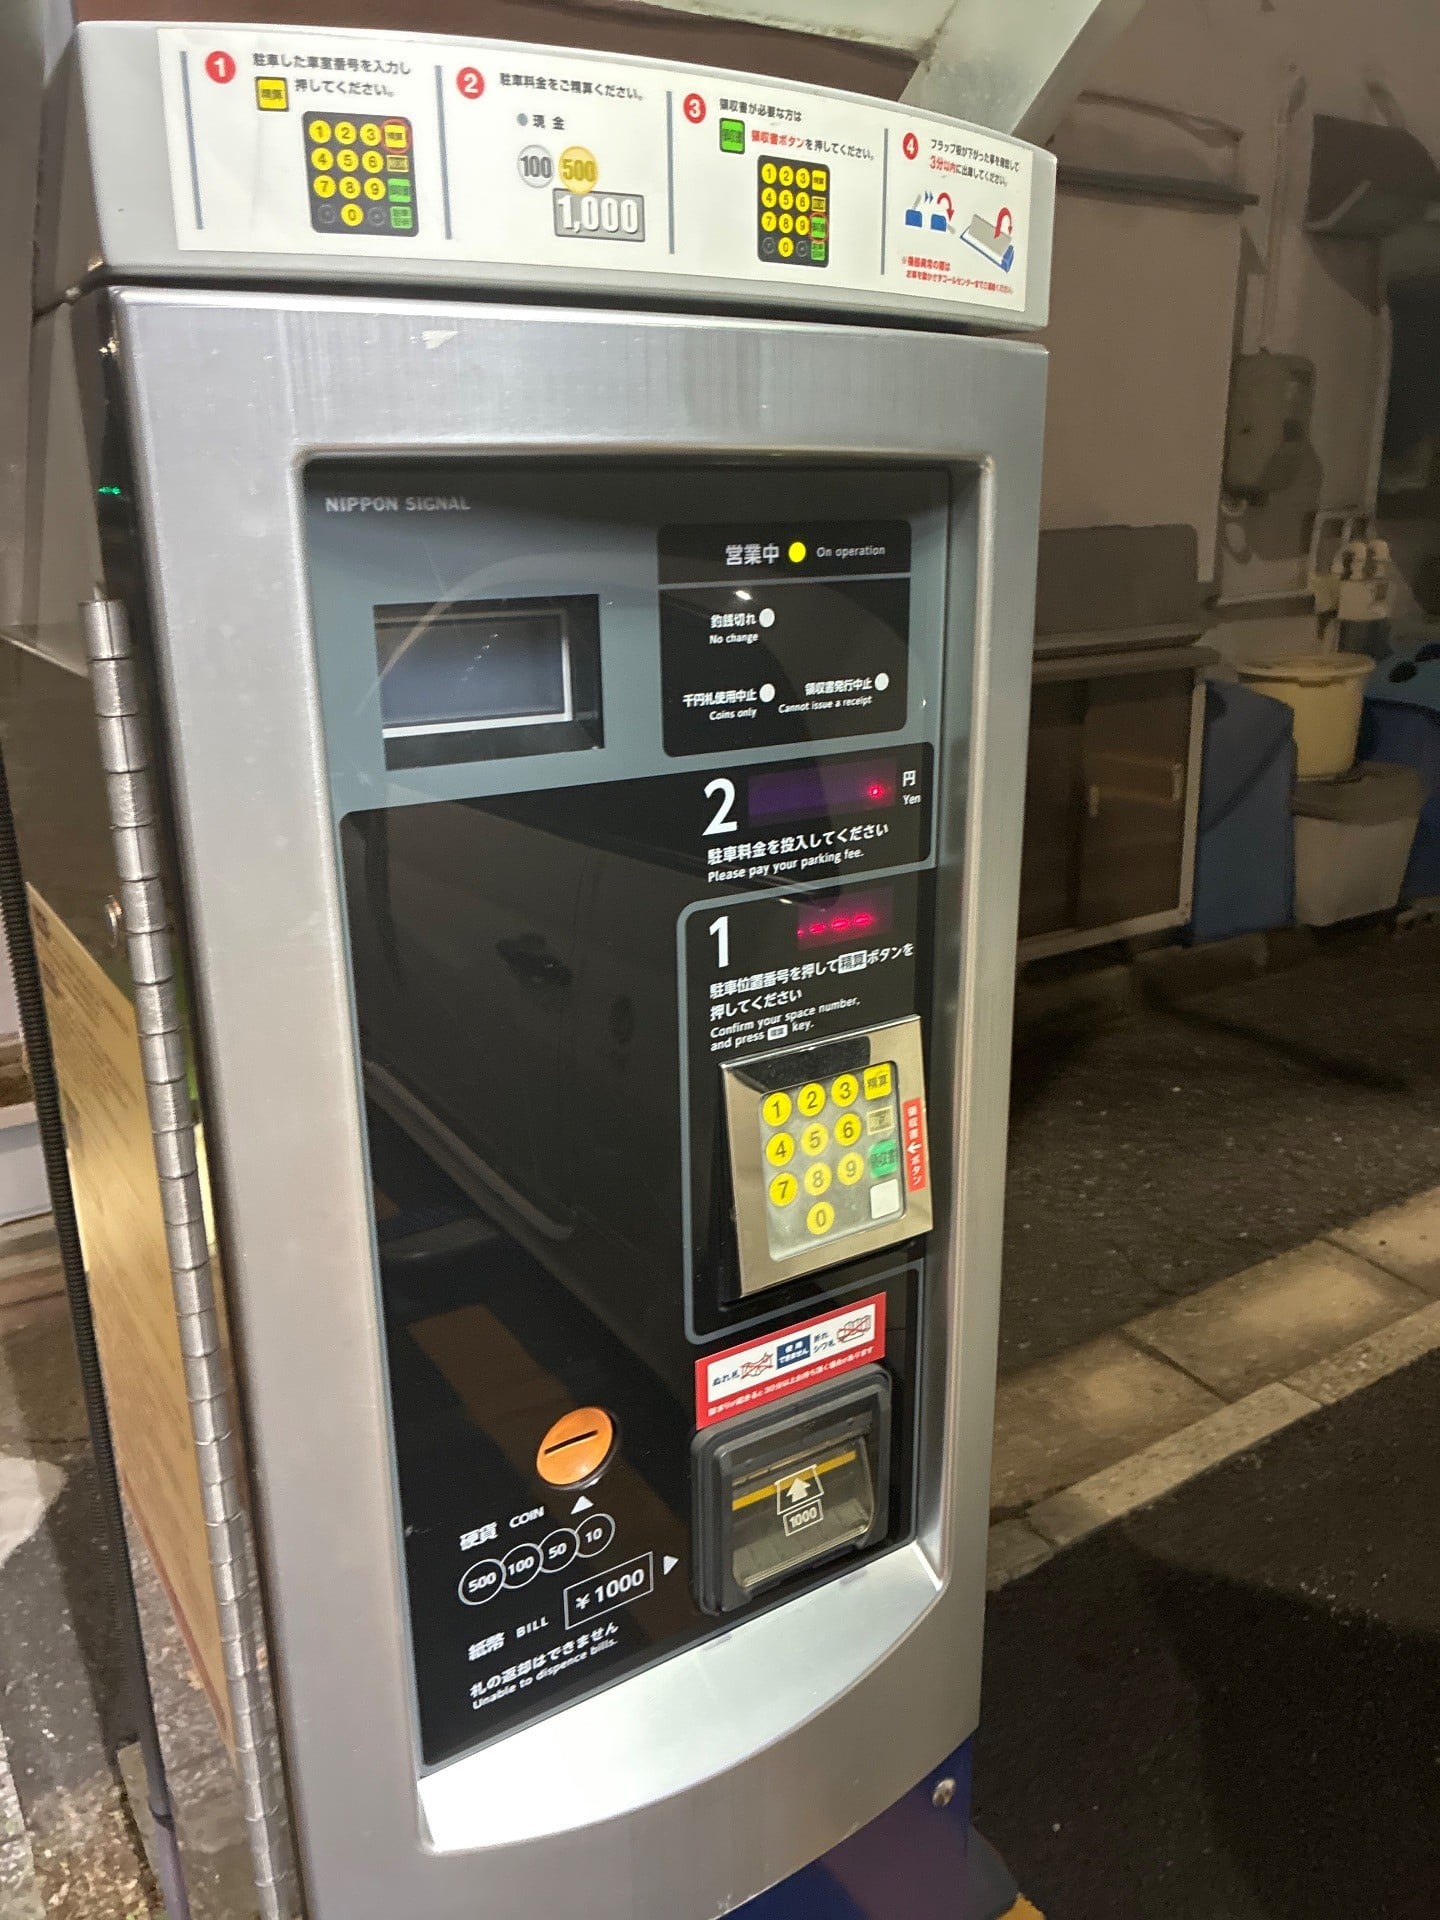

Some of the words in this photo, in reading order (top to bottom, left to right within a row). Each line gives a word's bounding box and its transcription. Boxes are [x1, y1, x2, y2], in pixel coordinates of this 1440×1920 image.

[213, 58, 226, 77] 1
[463, 73, 478, 93] 2
[689, 99, 702, 119] 3
[520, 156, 552, 179] 100
[562, 159, 597, 182] 500
[556, 195, 639, 234] 1,000
[325, 496, 399, 512] NIPPON
[406, 496, 471, 511] SIGNAL
[725, 543, 780, 566] 営業中
[816, 547, 833, 558] On
[835, 545, 886, 559] operation
[710, 612, 757, 628] 釣銭切れ
[709, 634, 723, 644] No
[726, 632, 759, 645] change
[682, 690, 757, 707] 千円札使用中止
[778, 701, 810, 714] Cannot
[811, 700, 833, 711] issue
[843, 695, 873, 709] receipt
[709, 709, 735, 721] Coins
[737, 707, 757, 720] only
[902, 770, 917, 787] 円
[702, 777, 738, 836] 2
[902, 794, 922, 806] Yen
[707, 822, 889, 865] 駐車料金を投入してください
[708, 867, 746, 883] Please
[748, 864, 770, 880] pay
[772, 860, 798, 876] your
[801, 851, 842, 870] parking
[844, 847, 864, 860] fee.
[708, 915, 729, 968] 1
[710, 988, 802, 1021] 押してください
[710, 1020, 754, 1039] Confirm
[757, 1015, 782, 1030] your
[784, 1006, 816, 1023] space
[710, 1038, 733, 1051] and
[735, 1031, 765, 1049] press
[792, 1020, 815, 1033] key.
[807, 1091, 817, 1109] 2
[839, 1082, 850, 1099] 3
[842, 1121, 853, 1139] 6
[775, 1141, 786, 1158] 4
[810, 1131, 820, 1149] 5
[846, 1160, 856, 1177] 9
[813, 1170, 823, 1188] 8
[778, 1181, 789, 1200] 7
[816, 1210, 827, 1227] 0
[509, 1506, 545, 1529] COIN
[789, 1507, 818, 1528] 1000
[585, 1527, 603, 1543] 10
[548, 1542, 567, 1560] 50
[507, 1556, 535, 1576] 100
[468, 1571, 497, 1593] 500
[516, 1616, 549, 1639] BILL
[469, 1622, 619, 1699] 札の返却はできません
[472, 1681, 517, 1710] Unable
[519, 1675, 534, 1688] to
